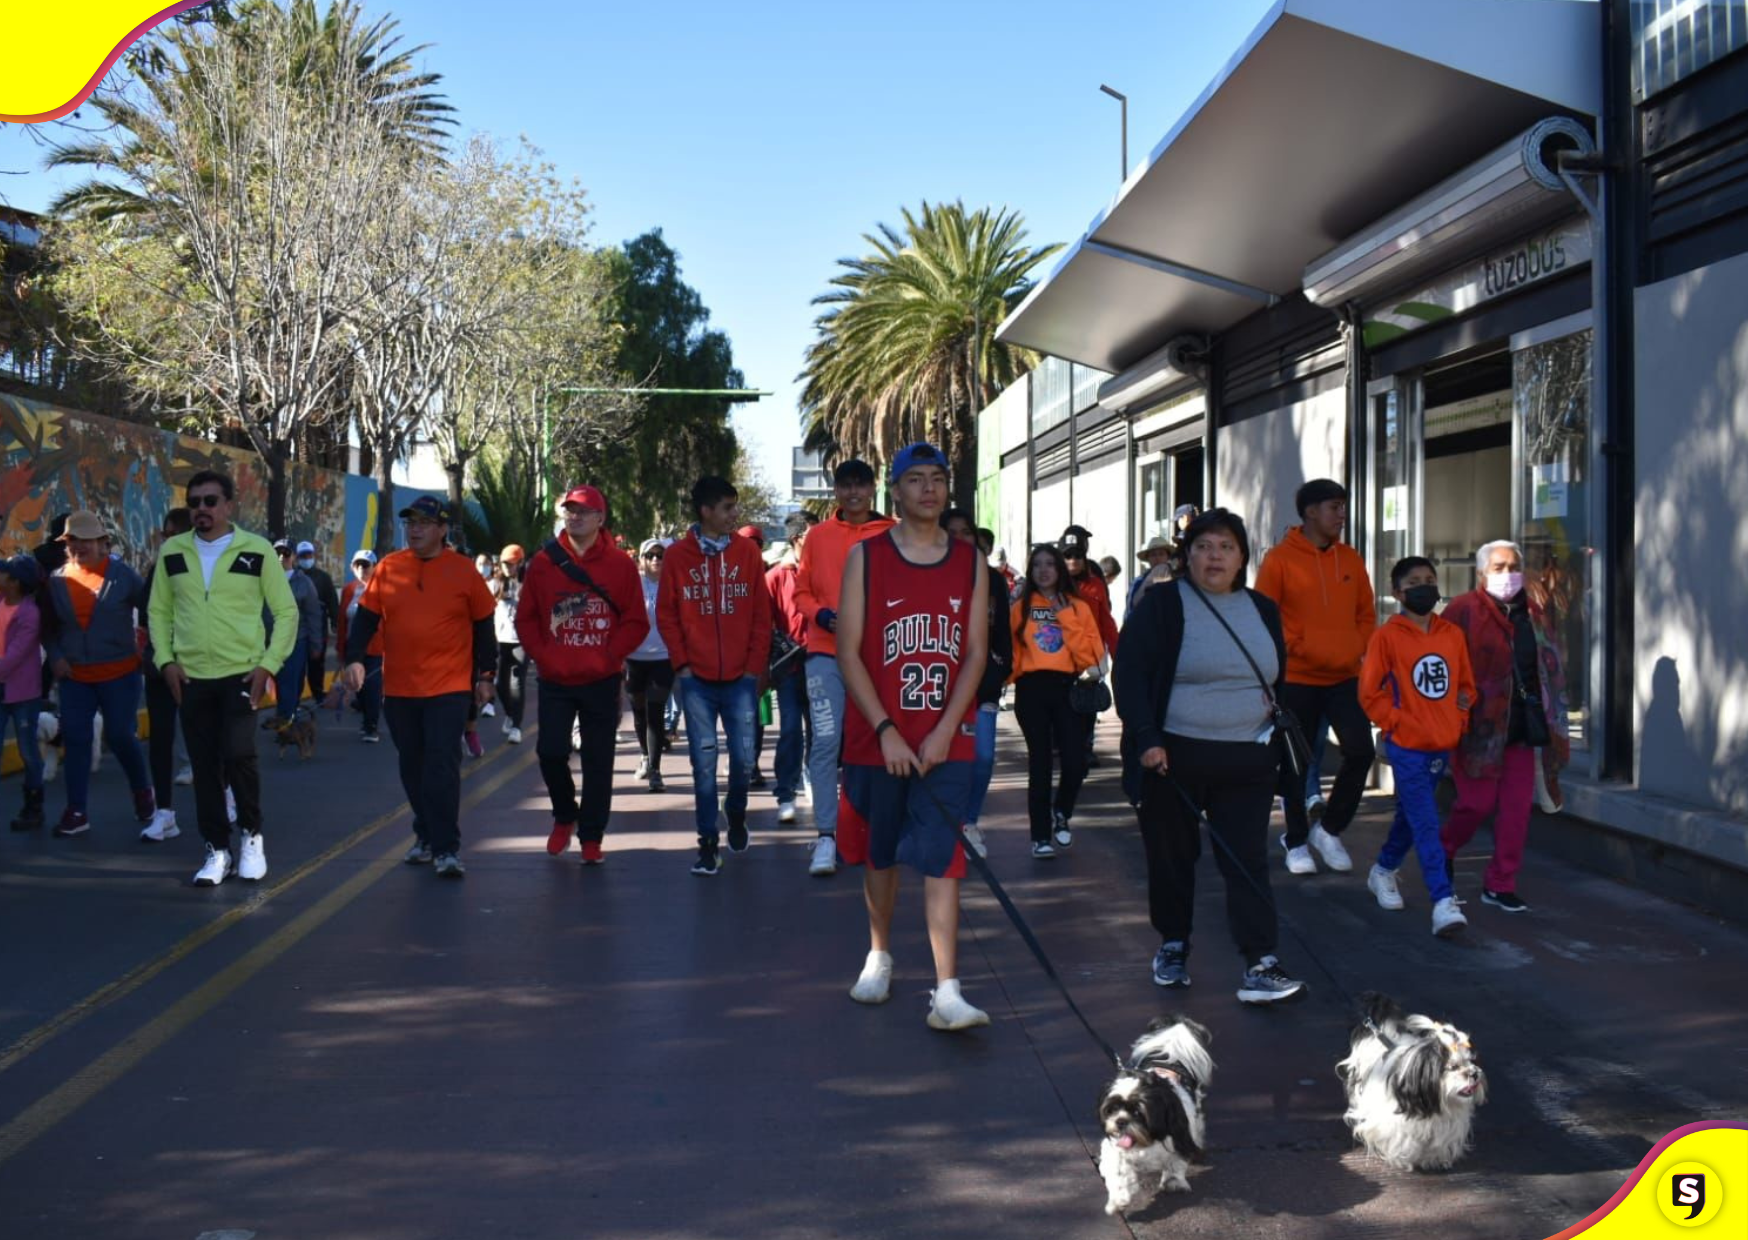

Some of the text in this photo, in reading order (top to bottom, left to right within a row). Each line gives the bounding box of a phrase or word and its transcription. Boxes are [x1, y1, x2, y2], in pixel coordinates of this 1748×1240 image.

[683, 584, 710, 600] NEW
[883, 613, 962, 666] BULLS
[900, 662, 949, 710] 23
[1417, 660, 1448, 693] 悟
[814, 698, 836, 737] NIKE
